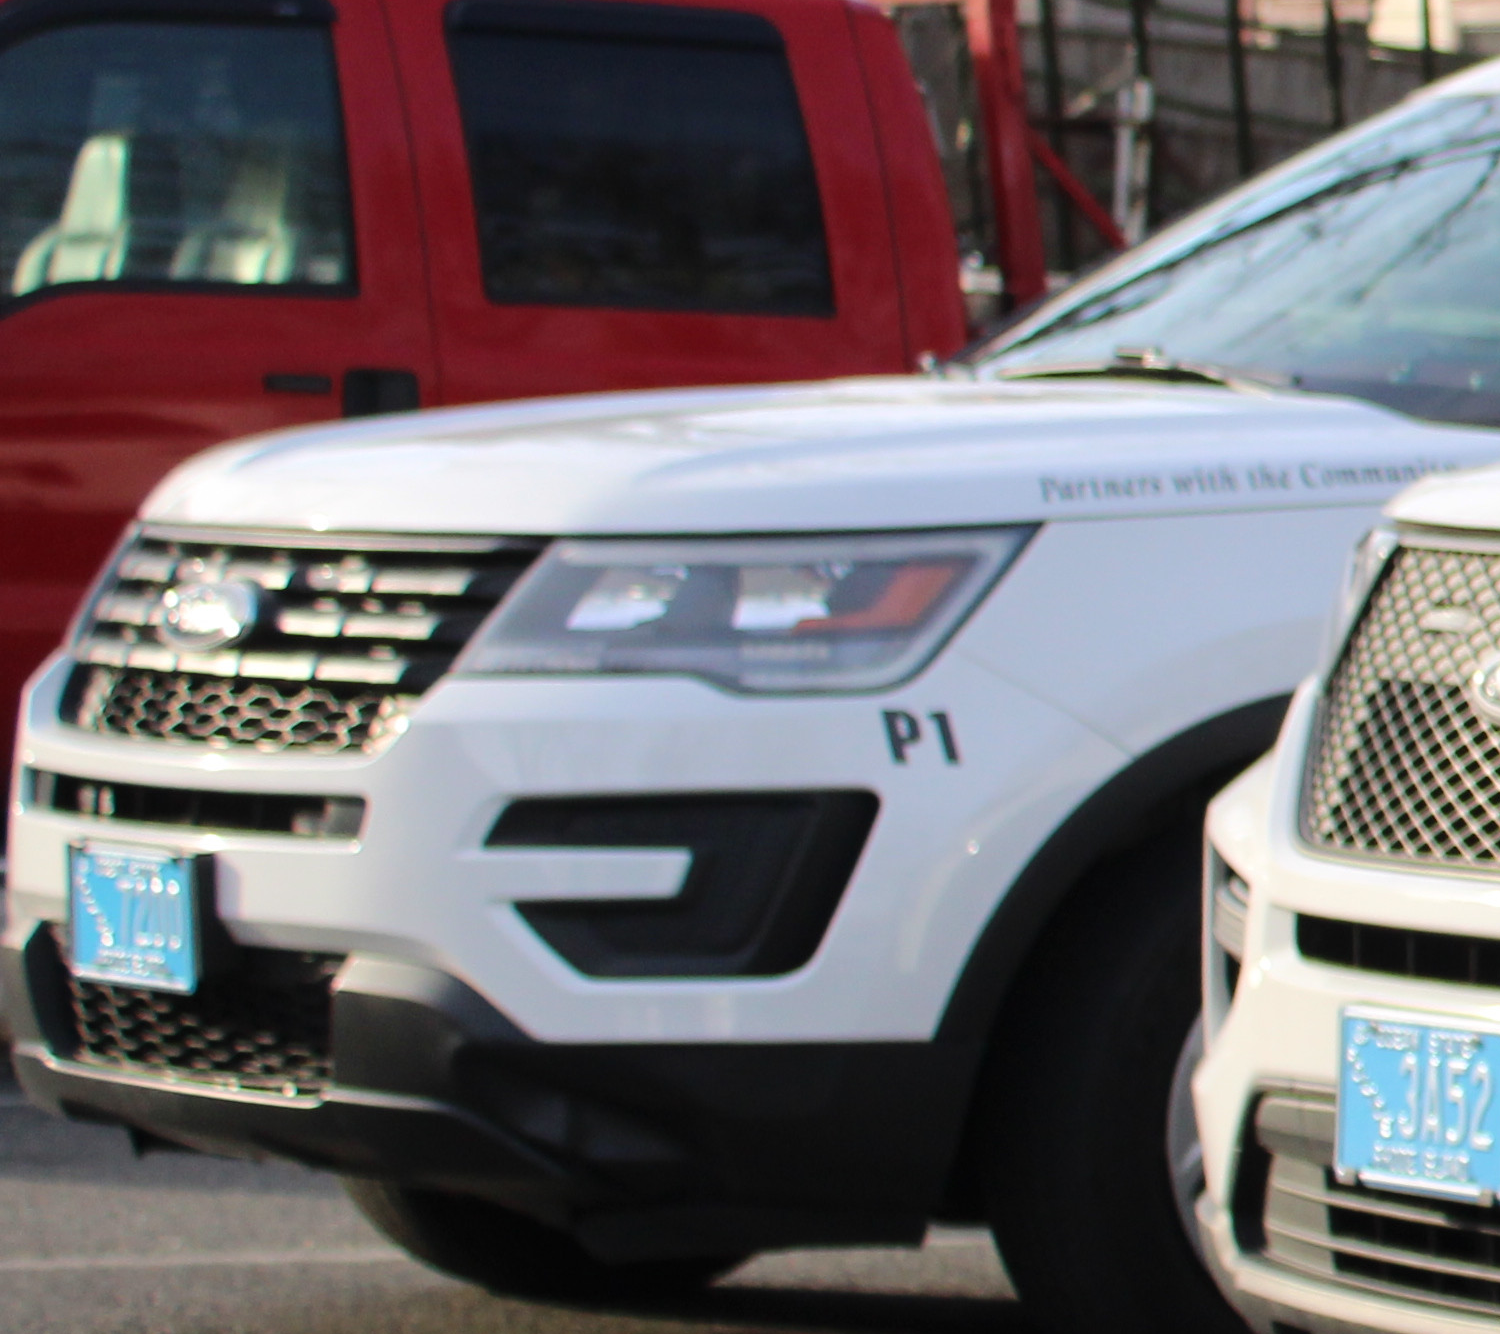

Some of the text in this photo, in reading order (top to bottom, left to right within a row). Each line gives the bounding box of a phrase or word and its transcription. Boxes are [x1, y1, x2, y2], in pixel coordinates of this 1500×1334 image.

[1038, 476, 1161, 504] Partners
[1171, 463, 1237, 495] with
[1247, 461, 1289, 491] the
[880, 708, 962, 766] P1
[1398, 1052, 1494, 1151] 3A52
